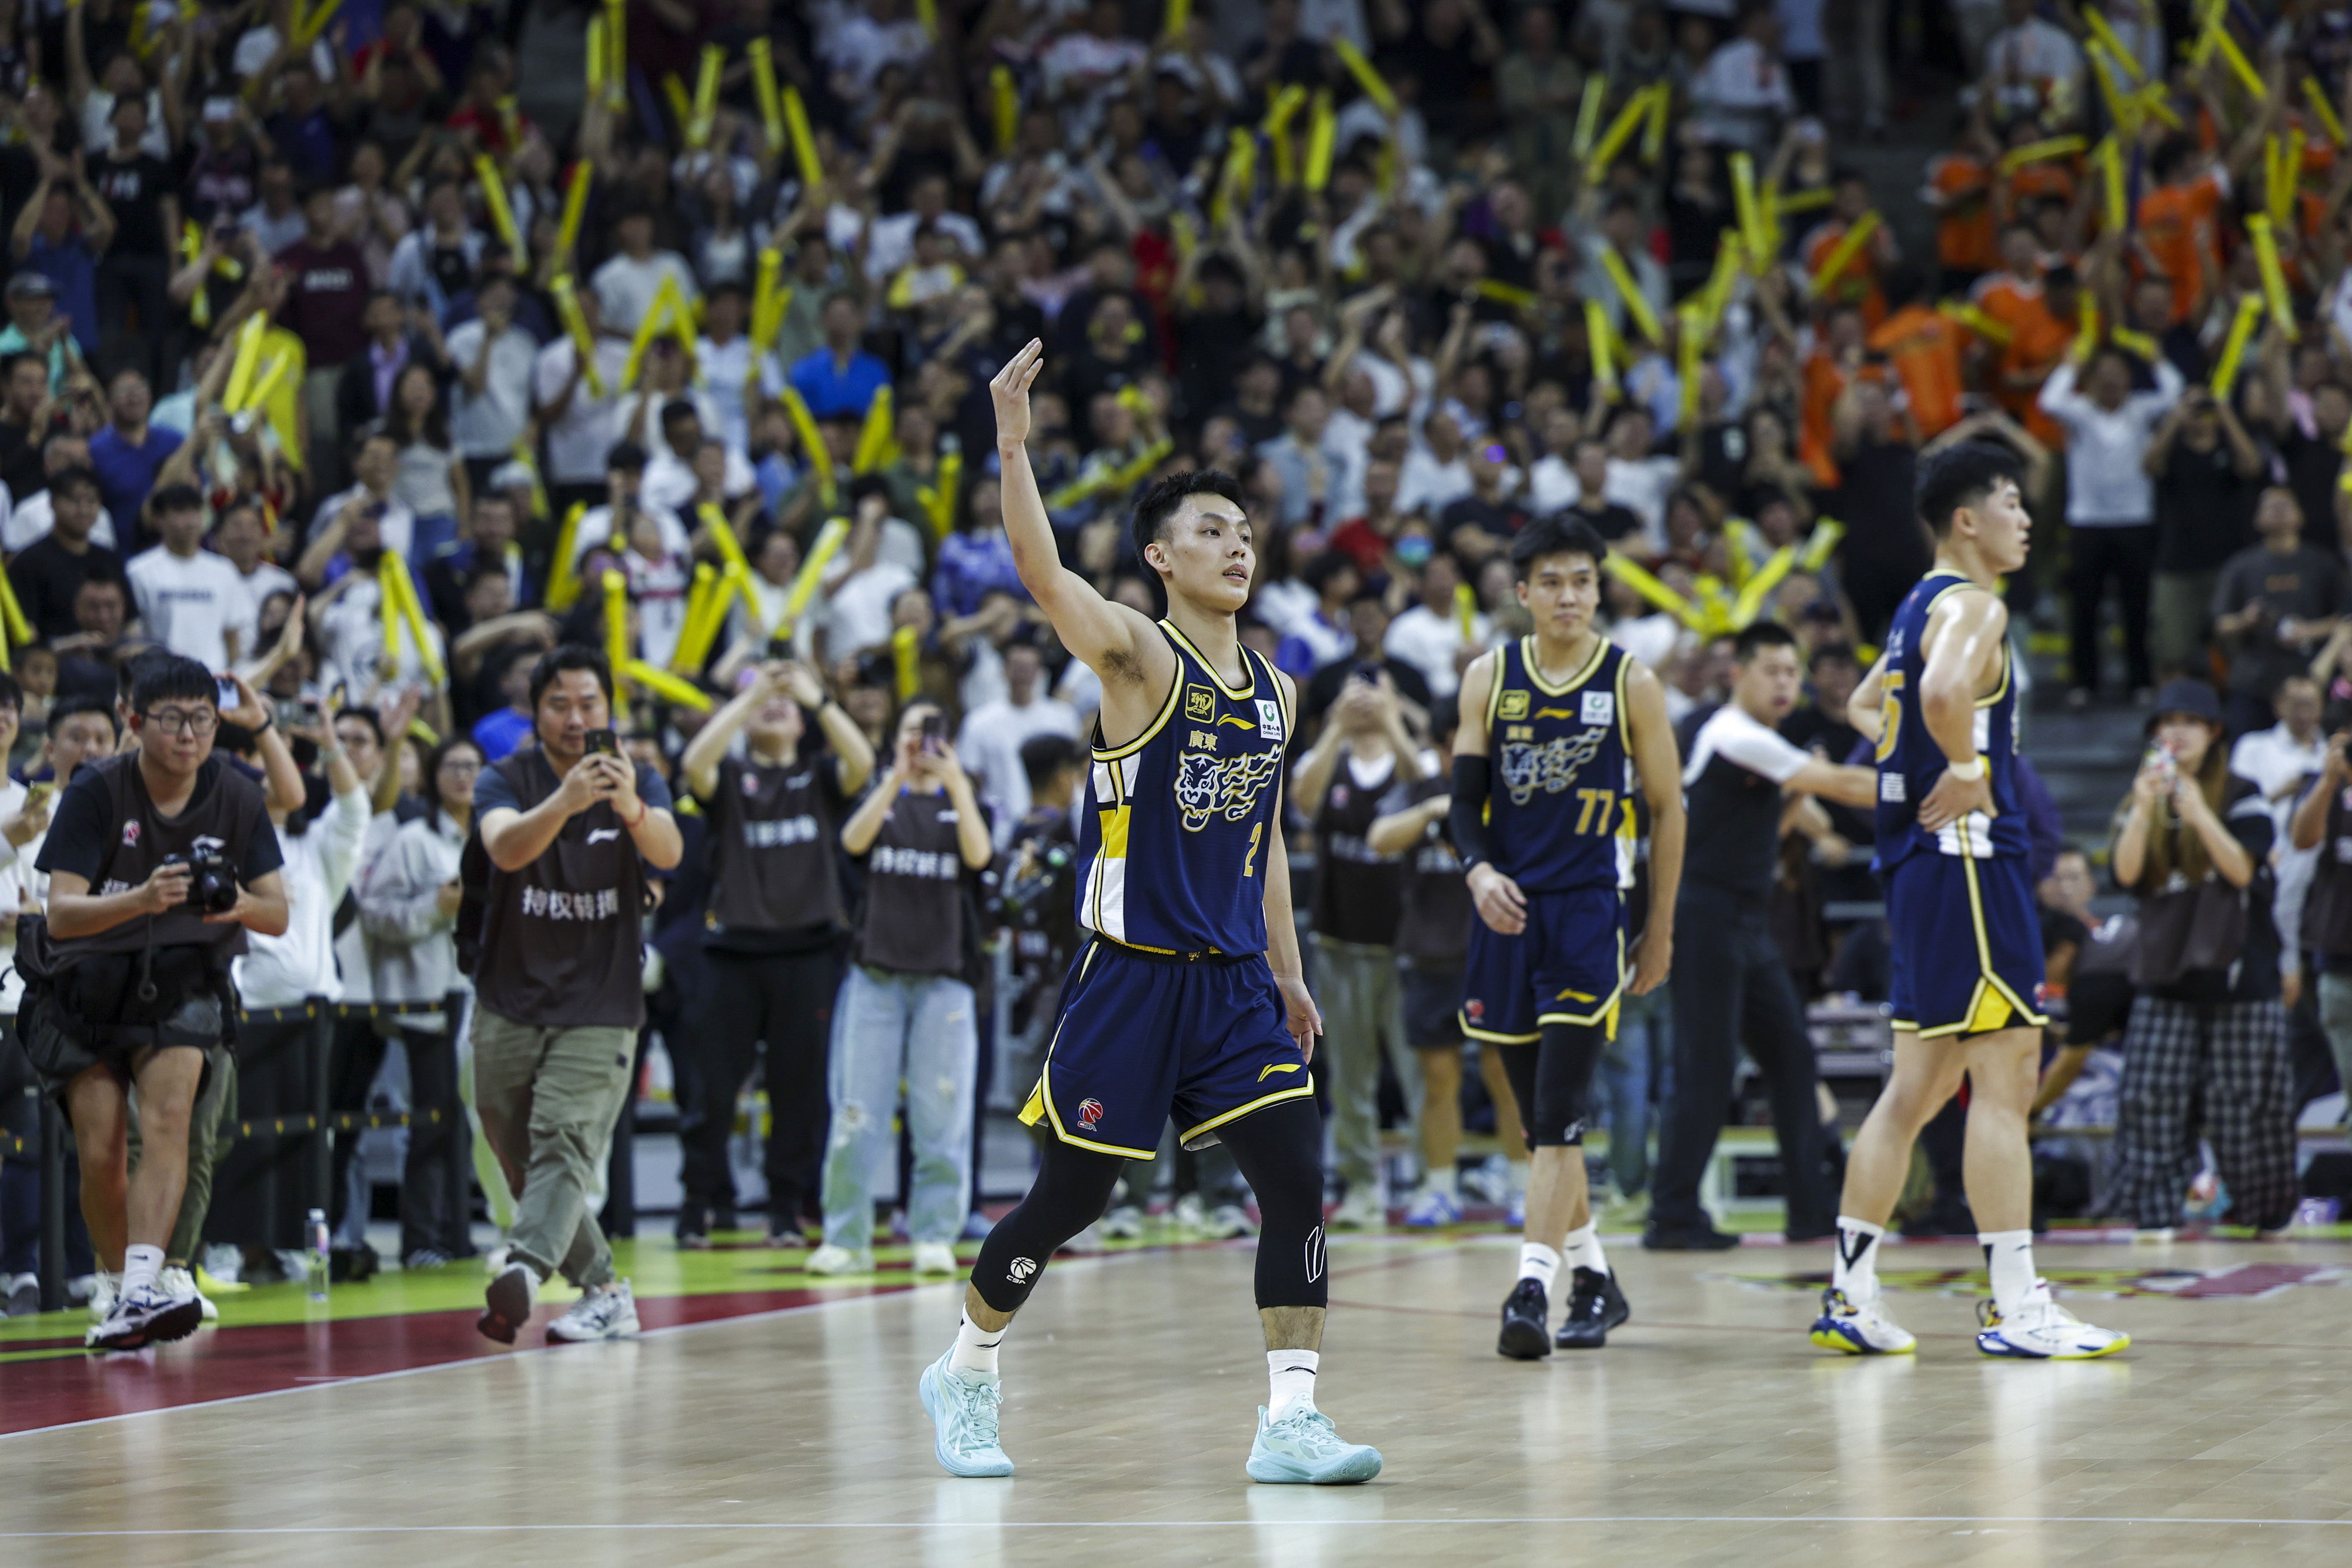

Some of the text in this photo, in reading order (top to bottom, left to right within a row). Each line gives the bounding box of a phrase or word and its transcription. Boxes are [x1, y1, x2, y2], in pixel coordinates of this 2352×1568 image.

[1188, 730, 1218, 751] 廣東
[1575, 788, 1615, 836] 77
[1243, 822, 1262, 877] 2
[1078, 1121, 1097, 1132] CBA
[1006, 1275, 1026, 1284] CBA
